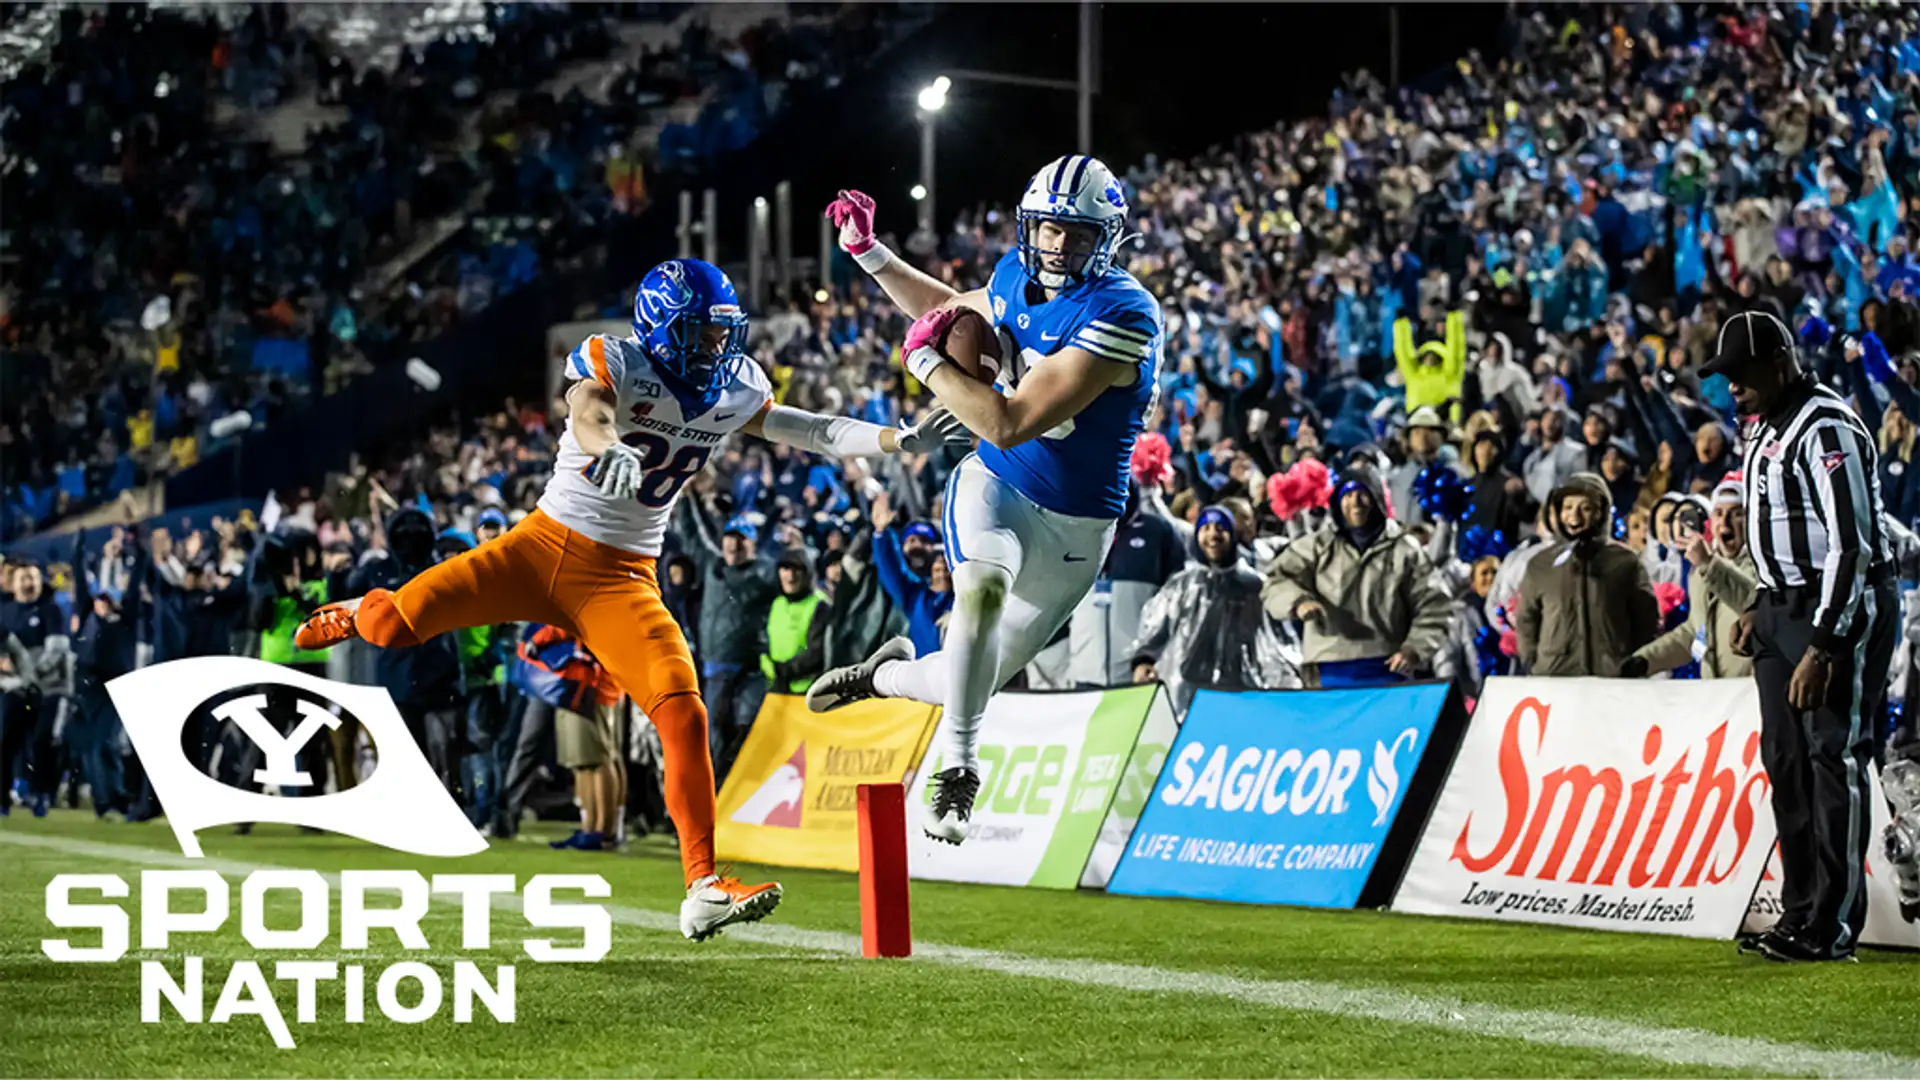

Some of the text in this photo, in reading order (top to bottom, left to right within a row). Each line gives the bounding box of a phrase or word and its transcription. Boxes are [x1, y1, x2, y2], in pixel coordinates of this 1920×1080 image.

[629, 414, 682, 437] BOISE
[1758, 474, 1767, 495] S
[1161, 741, 1361, 816] SAGICOR
[1448, 696, 1770, 889] Smith's
[1132, 833, 1180, 860] LIFE
[1177, 837, 1284, 870] INSURANCE
[1283, 842, 1376, 870] COMPANY
[1461, 881, 1503, 907] Low
[1494, 889, 1568, 914] prices.
[1569, 894, 1645, 921] Market
